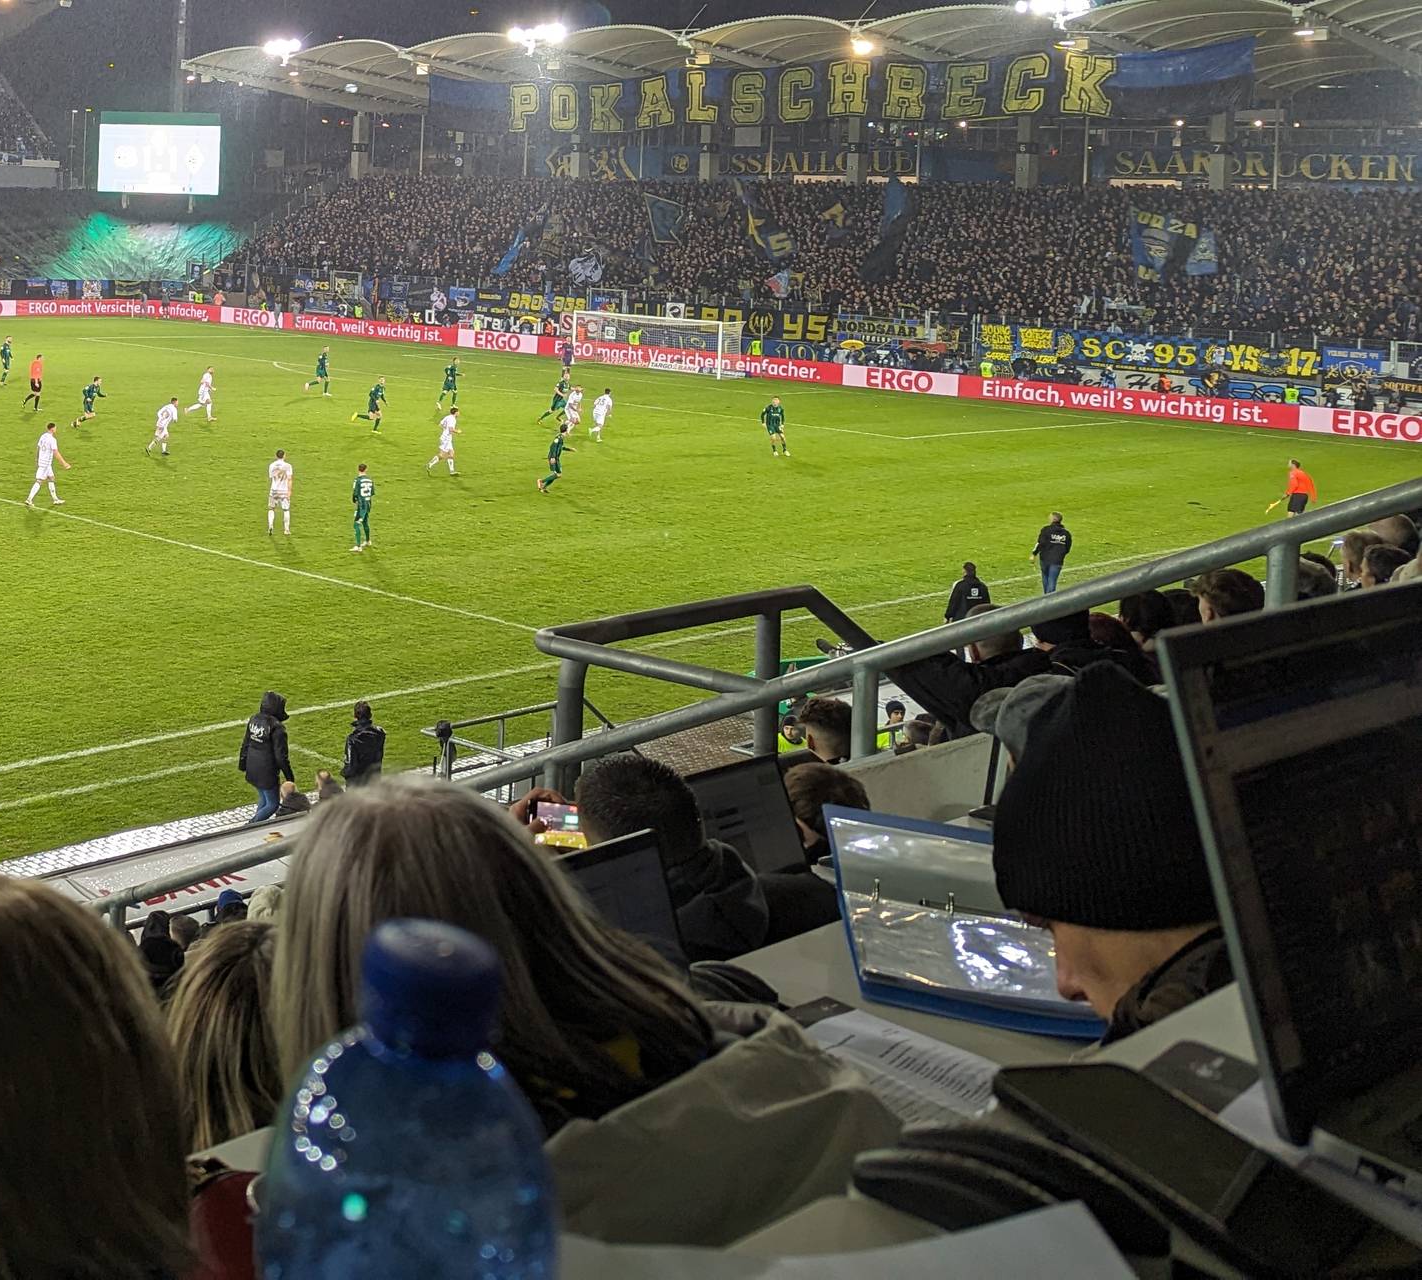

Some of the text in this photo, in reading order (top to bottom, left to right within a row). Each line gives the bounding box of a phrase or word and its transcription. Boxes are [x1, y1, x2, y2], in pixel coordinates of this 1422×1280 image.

[509, 51, 1116, 132] POKALSCHRECK
[28, 302, 57, 314] ERGO
[59, 300, 93, 313] macht
[233, 311, 270, 325] ERGO
[295, 315, 443, 343] Einfach, weil's wichtig ist.
[474, 331, 521, 352] ERGO
[554, 340, 593, 357] EGO
[735, 353, 821, 381] einfacher.
[1153, 343, 1197, 367] 95
[865, 369, 933, 393] ERGO
[982, 380, 1065, 408] Einfach,
[1070, 389, 1134, 411] weil's
[1139, 392, 1225, 423] wichtig
[1232, 400, 1269, 424] ist.
[1332, 410, 1422, 442] ERGO
